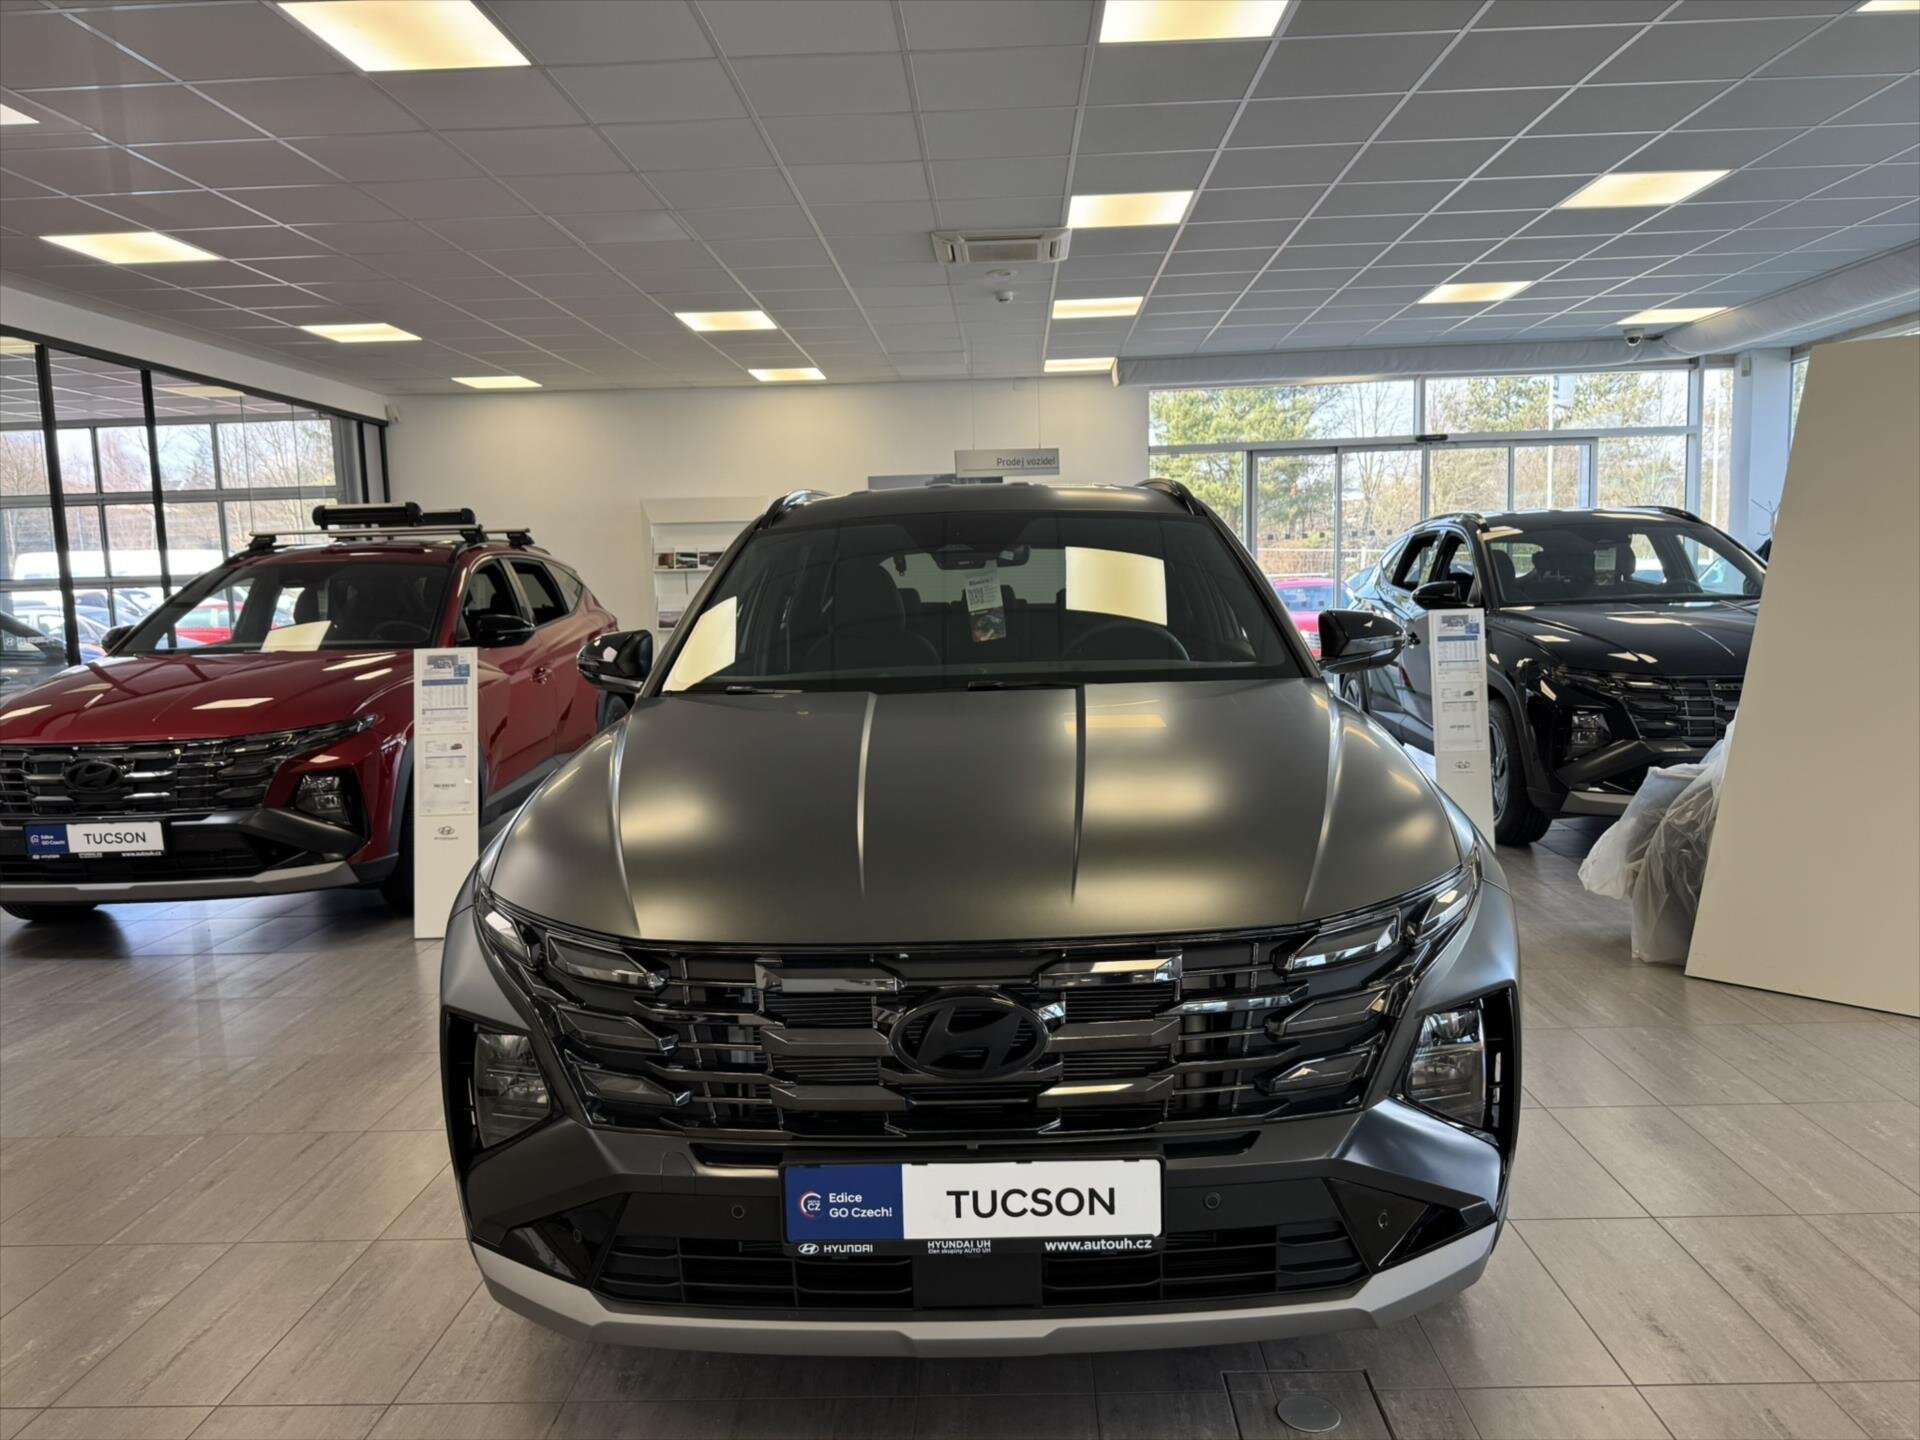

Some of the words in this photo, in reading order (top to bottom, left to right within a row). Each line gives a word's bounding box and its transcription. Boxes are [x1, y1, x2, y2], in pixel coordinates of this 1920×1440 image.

[996, 457, 1025, 468] Prodej
[1026, 456, 1056, 466] vozidel
[83, 832, 146, 845] TUCSON
[829, 1193, 863, 1204] Edice
[946, 1187, 1115, 1219] TUCSON
[829, 1208, 849, 1218] GO
[851, 1206, 893, 1218] Czech!
[823, 1244, 873, 1253] HYUNDAI
[927, 1240, 974, 1249] HYUNDAI
[976, 1240, 991, 1248] UH
[1045, 1238, 1153, 1251] www.autouh.cz
